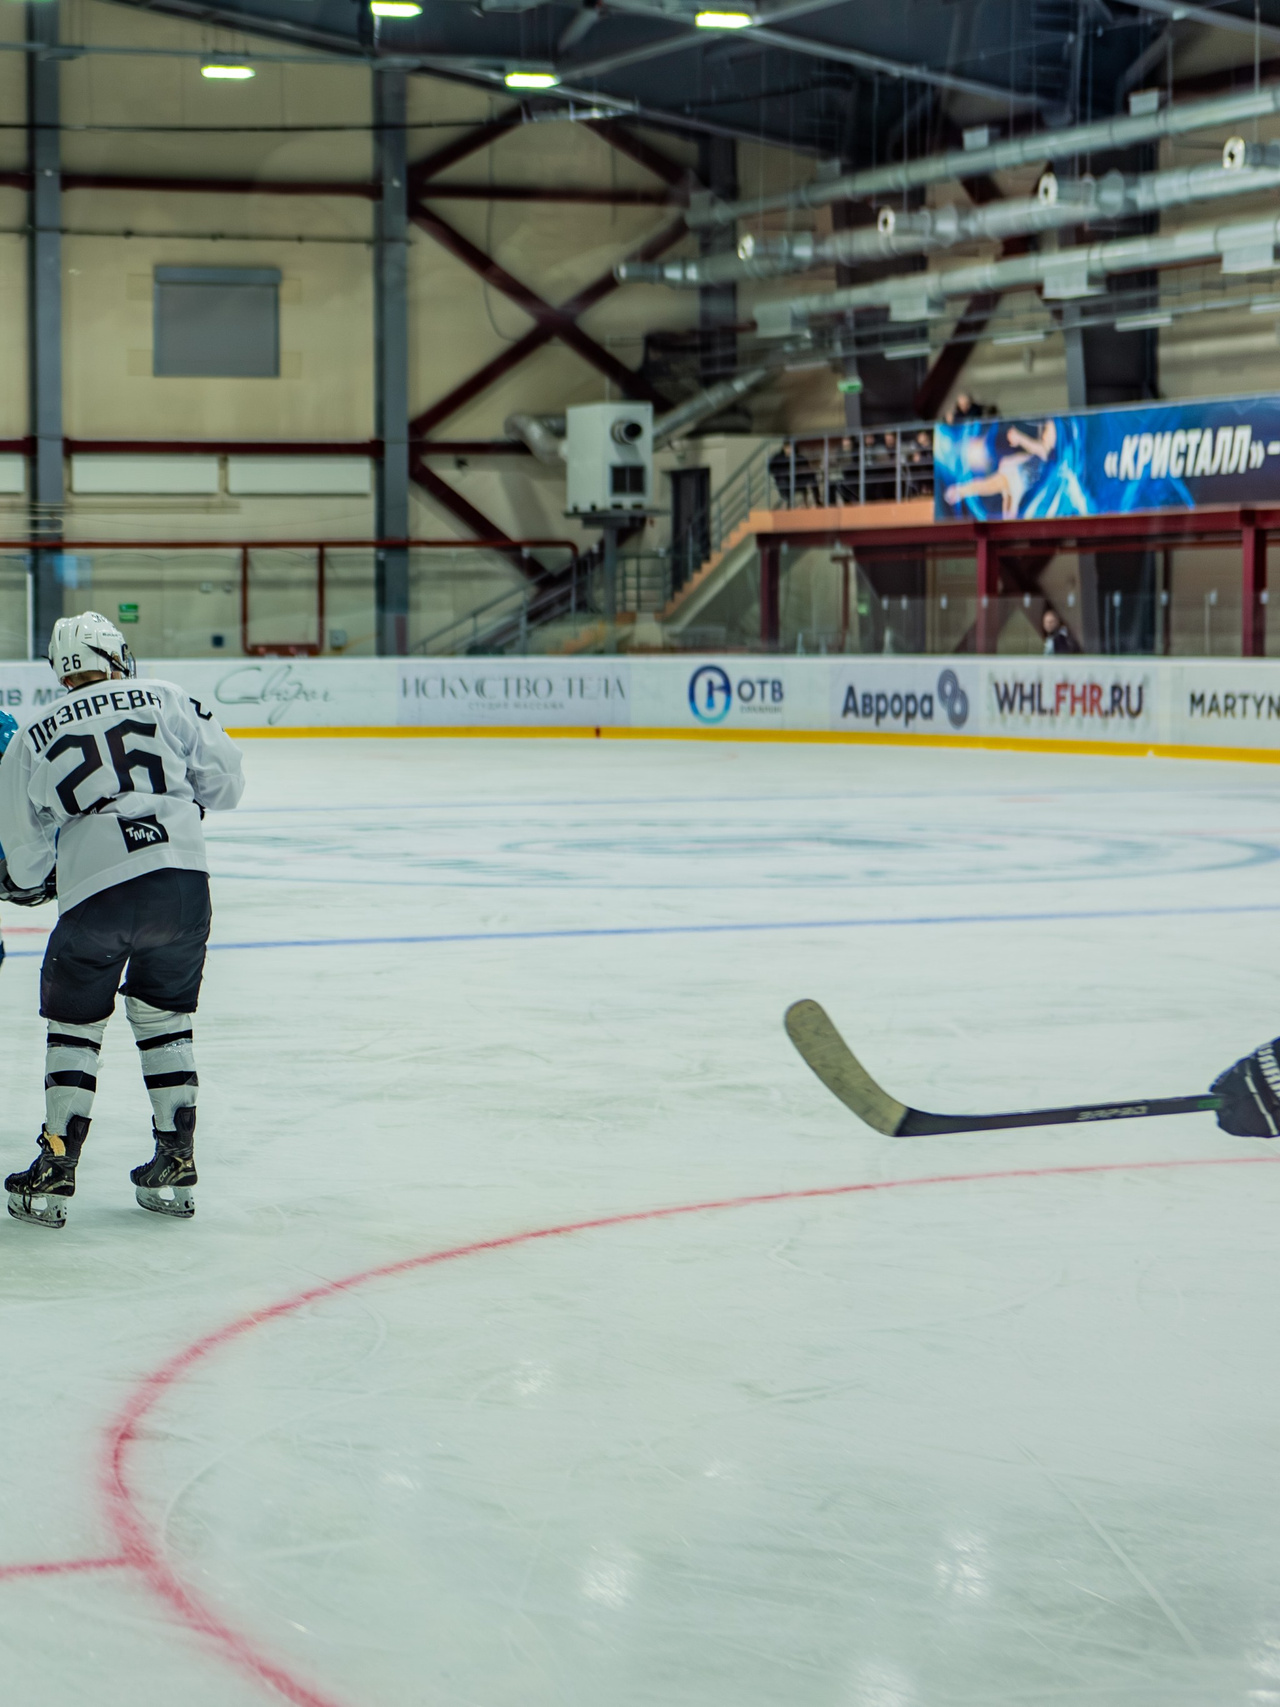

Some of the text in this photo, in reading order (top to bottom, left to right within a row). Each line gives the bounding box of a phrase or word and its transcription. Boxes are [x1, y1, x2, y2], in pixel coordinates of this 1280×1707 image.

[61, 654, 82, 672] 26
[737, 679, 784, 702] ОТВ
[841, 684, 934, 727] Аврора
[994, 681, 1144, 719] WHL.FHR.RU
[28, 689, 162, 754] ЛАЗАРЕВА
[45, 718, 168, 816] 26
